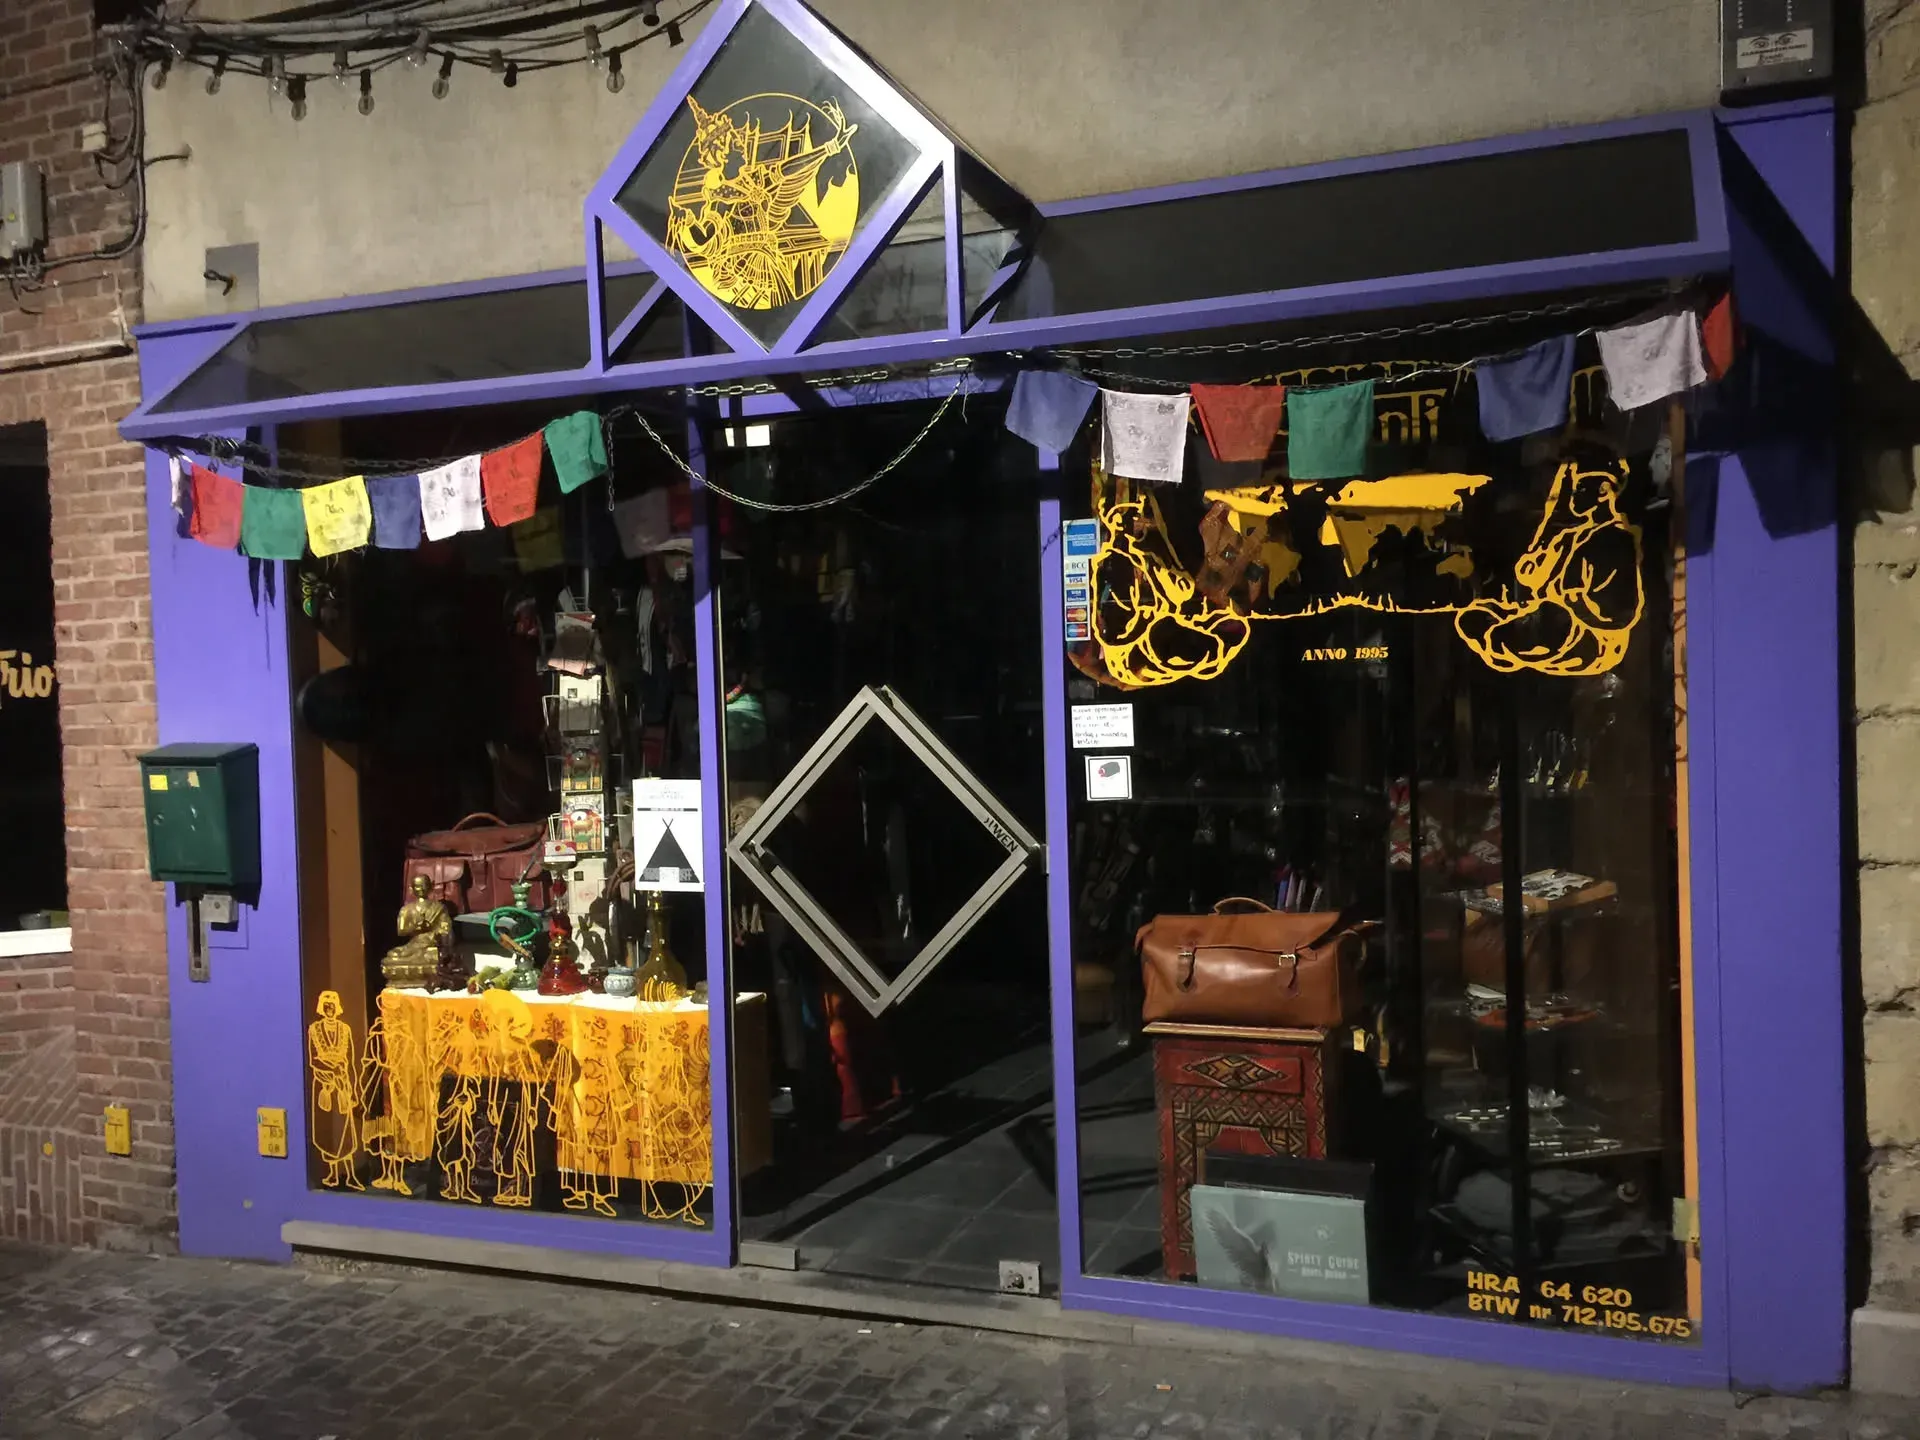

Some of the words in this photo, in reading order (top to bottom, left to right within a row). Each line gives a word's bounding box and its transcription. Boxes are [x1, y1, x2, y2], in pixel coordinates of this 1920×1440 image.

[1301, 647, 1347, 661] ANNO
[1354, 646, 1389, 660] 1995
[1468, 1271, 1520, 1294] HRA
[1540, 1281, 1573, 1301] 64
[1582, 1286, 1633, 1308] 620
[1468, 1293, 1520, 1316] BTW
[1529, 1304, 1552, 1320] nr
[1562, 1304, 1691, 1338] 712.195.675
